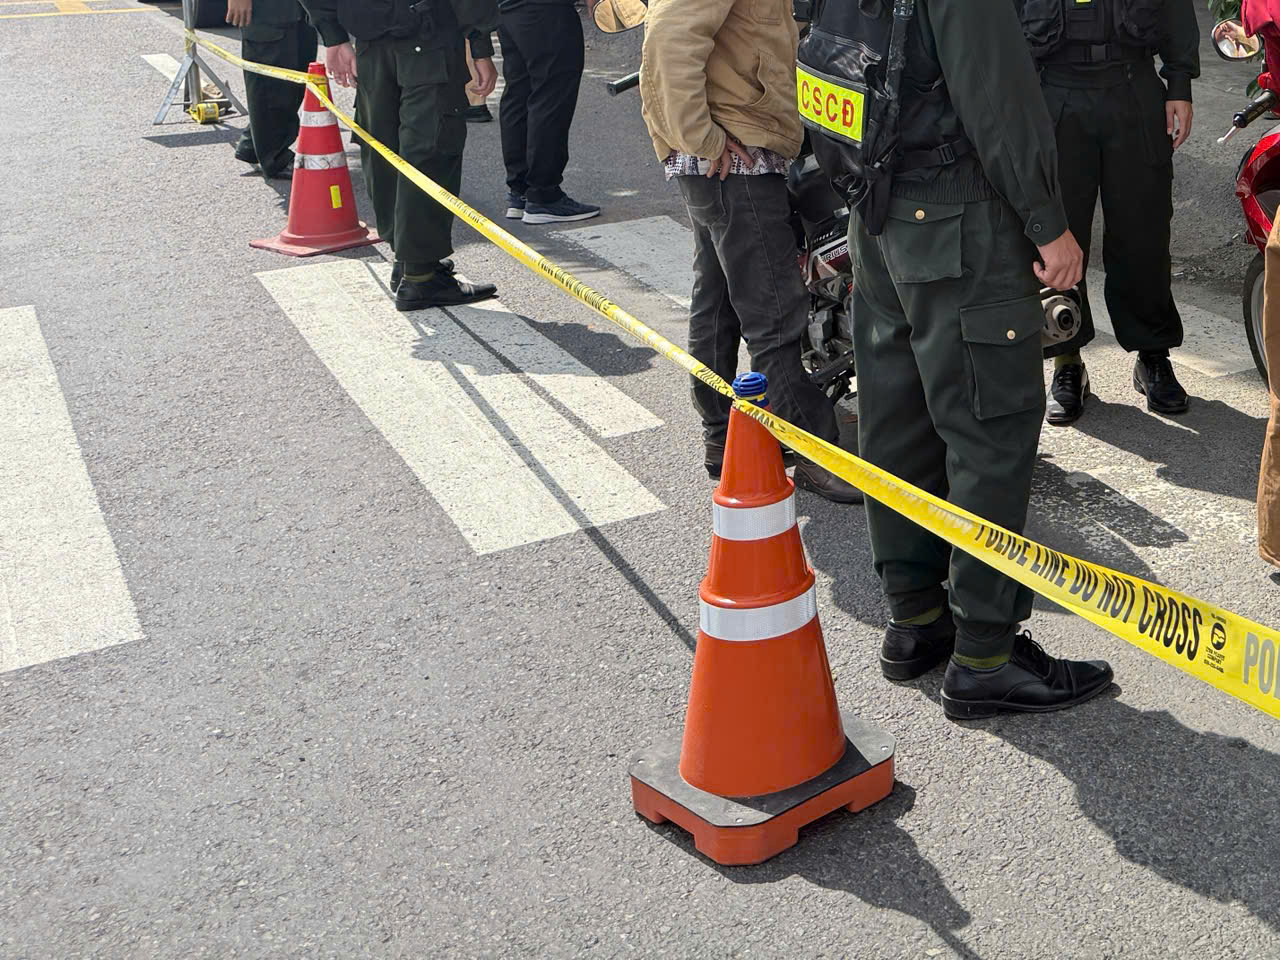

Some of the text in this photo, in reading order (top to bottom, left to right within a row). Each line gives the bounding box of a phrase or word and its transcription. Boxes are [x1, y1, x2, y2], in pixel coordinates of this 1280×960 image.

[801, 80, 855, 128] CSCĐ
[1030, 545, 1070, 588] LINE
[1069, 560, 1098, 602] DO
[1096, 568, 1136, 623] NOT
[1138, 584, 1202, 661] CROSS
